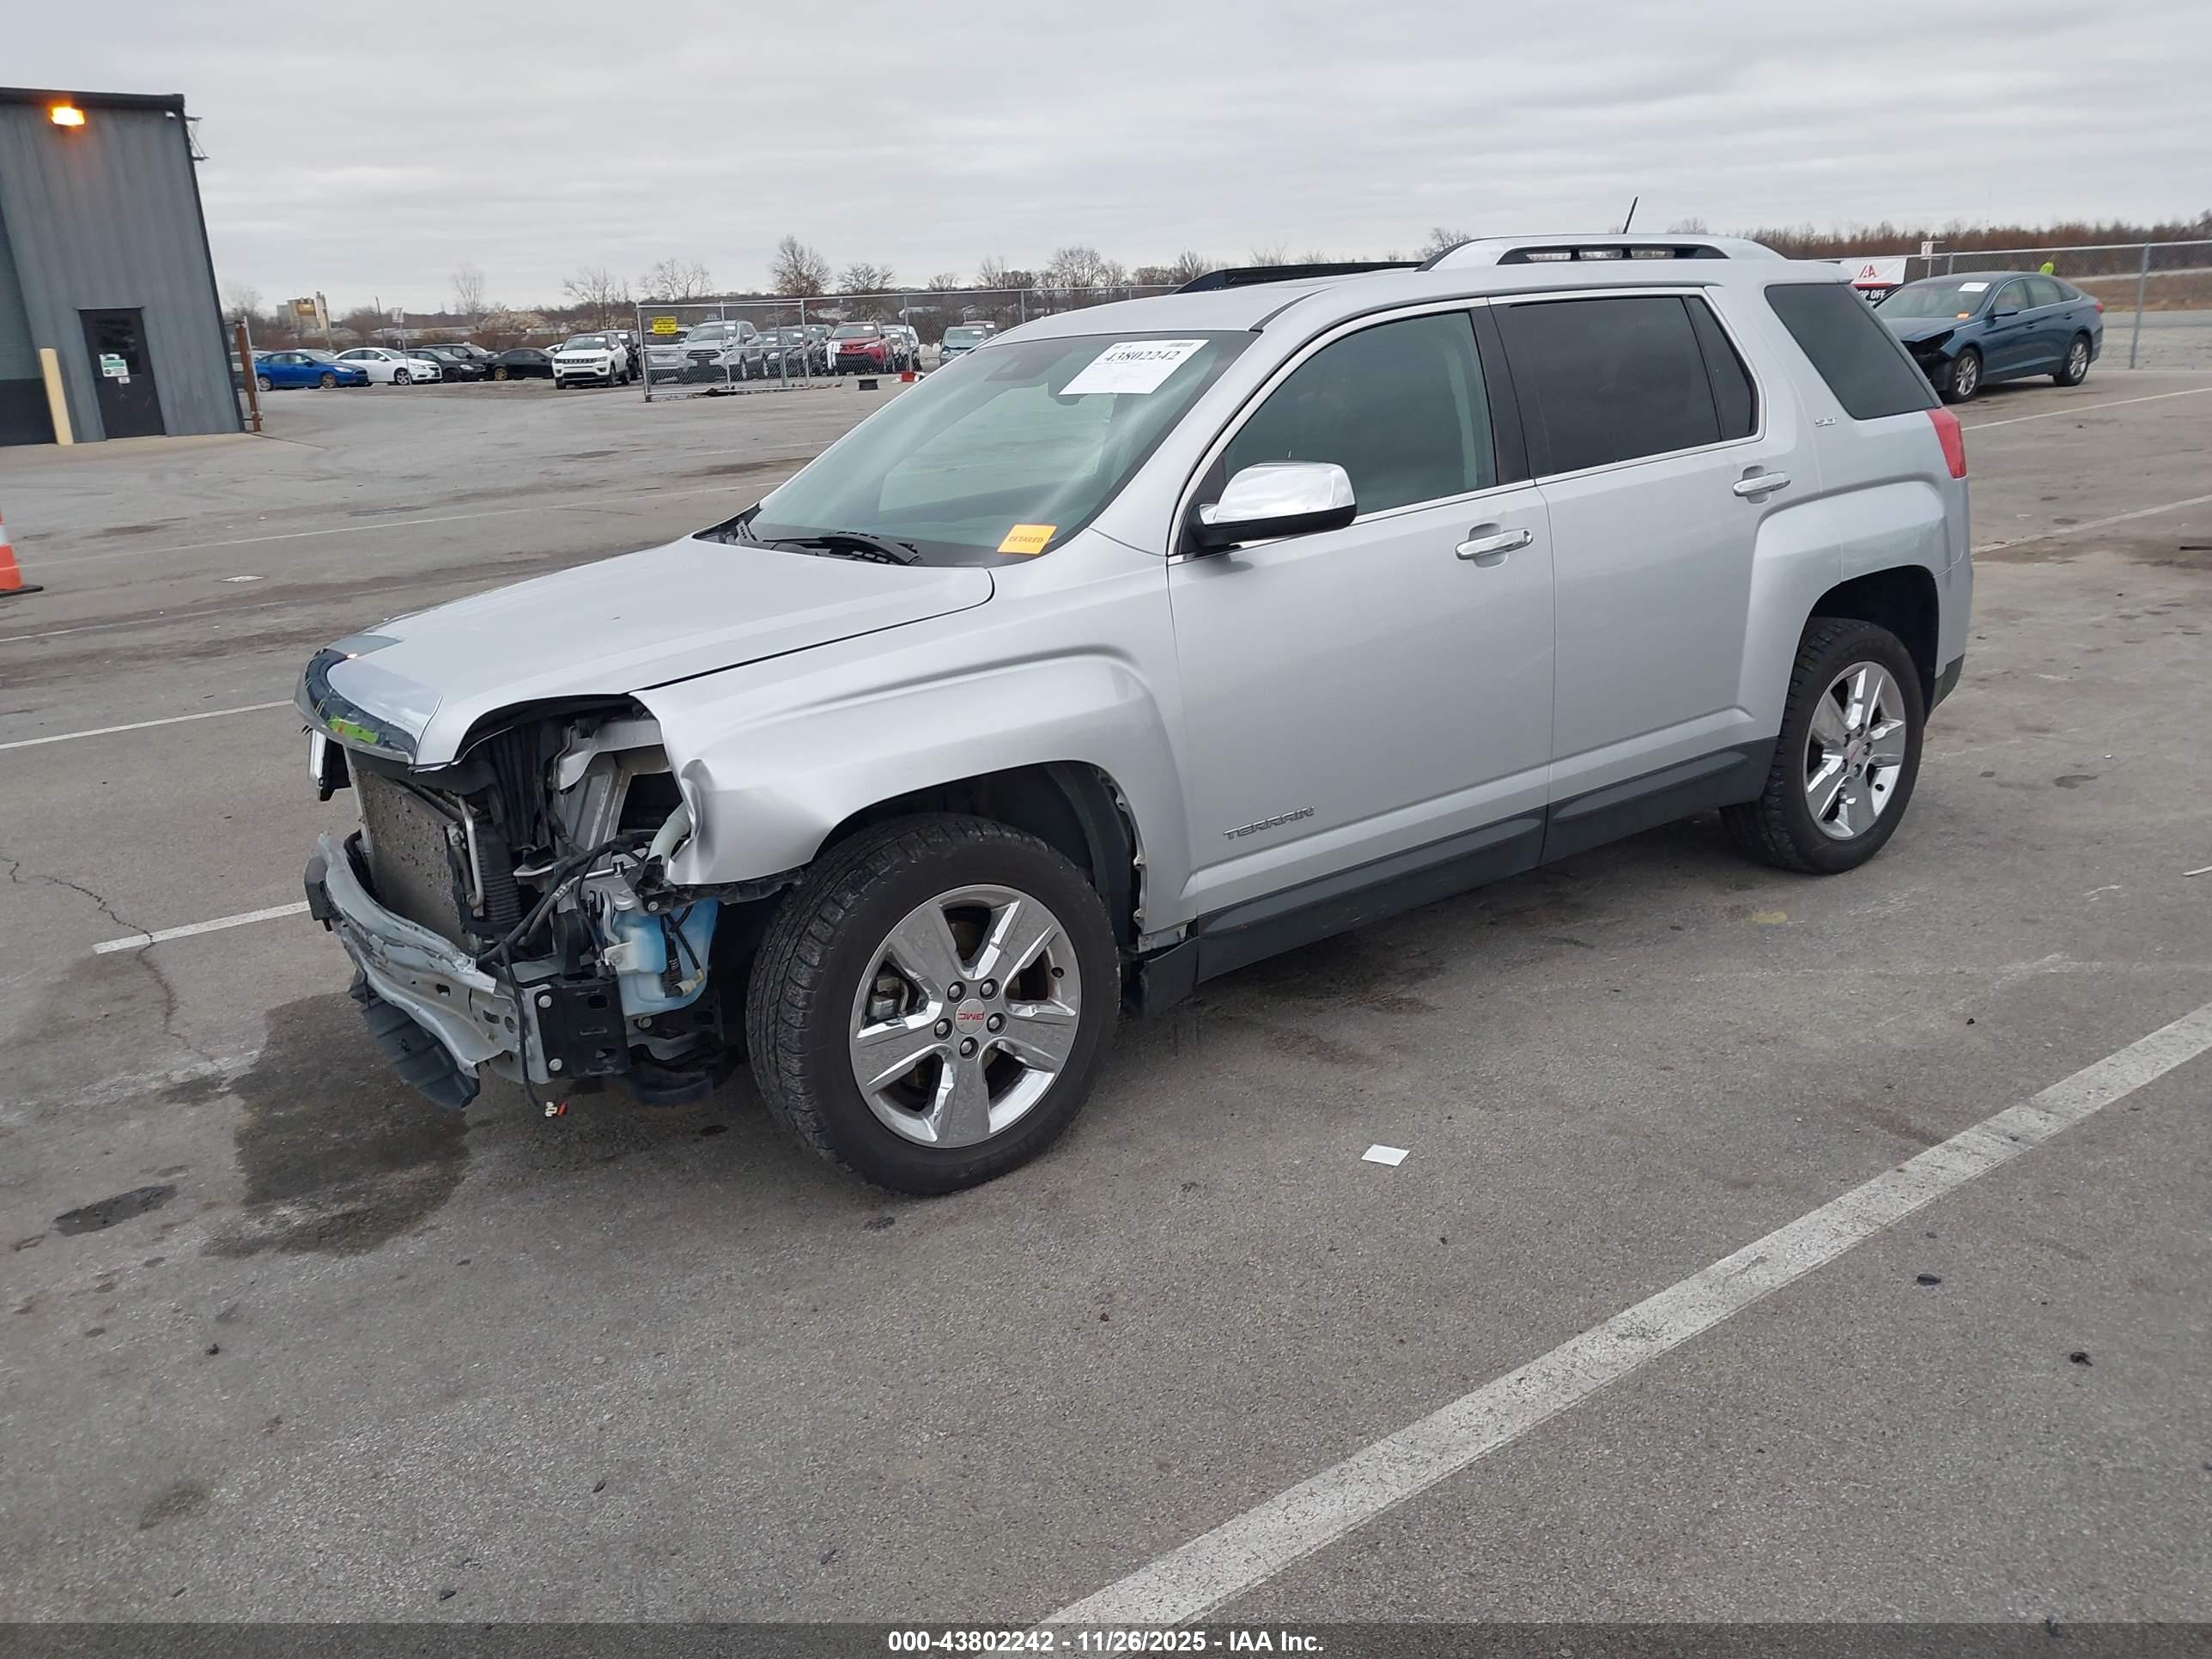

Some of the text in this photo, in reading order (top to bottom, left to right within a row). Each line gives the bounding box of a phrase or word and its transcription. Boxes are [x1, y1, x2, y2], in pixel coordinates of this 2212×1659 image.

[1870, 289, 1887, 299] OFF
[1104, 350, 1181, 362] 43802242
[1223, 805, 1316, 840] TERRAIN
[957, 1012, 985, 1021] GMC
